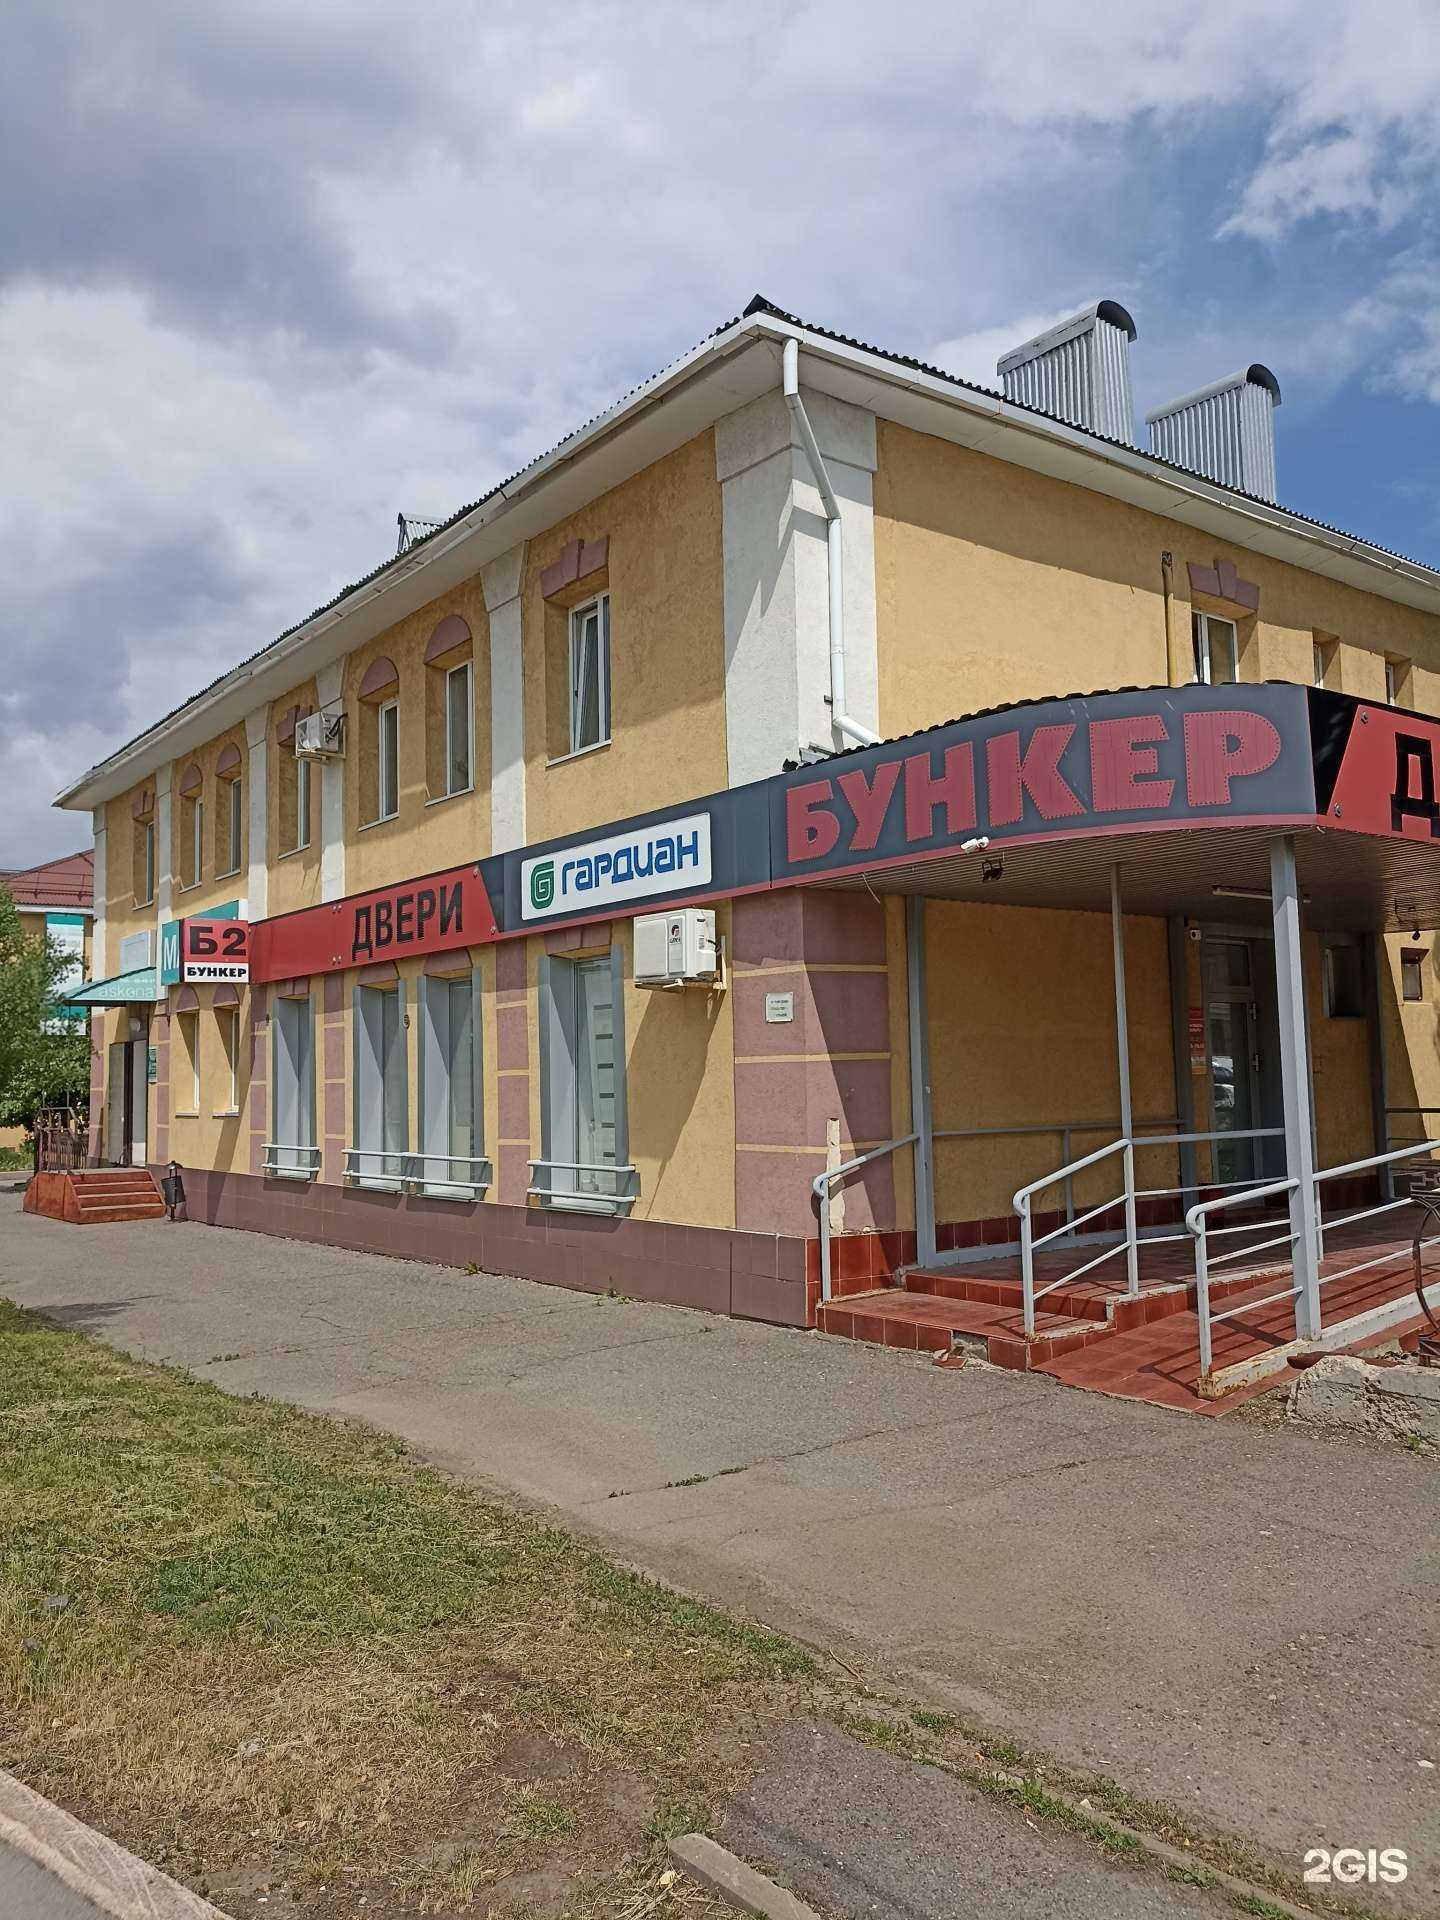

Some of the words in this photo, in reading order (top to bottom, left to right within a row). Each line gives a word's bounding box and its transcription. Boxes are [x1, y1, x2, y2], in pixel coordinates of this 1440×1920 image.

[786, 710, 1282, 863] БУНКЕР
[189, 925, 247, 956] Б2
[351, 880, 463, 961] ДВЕРИ
[187, 966, 247, 977] БУНКЕР
